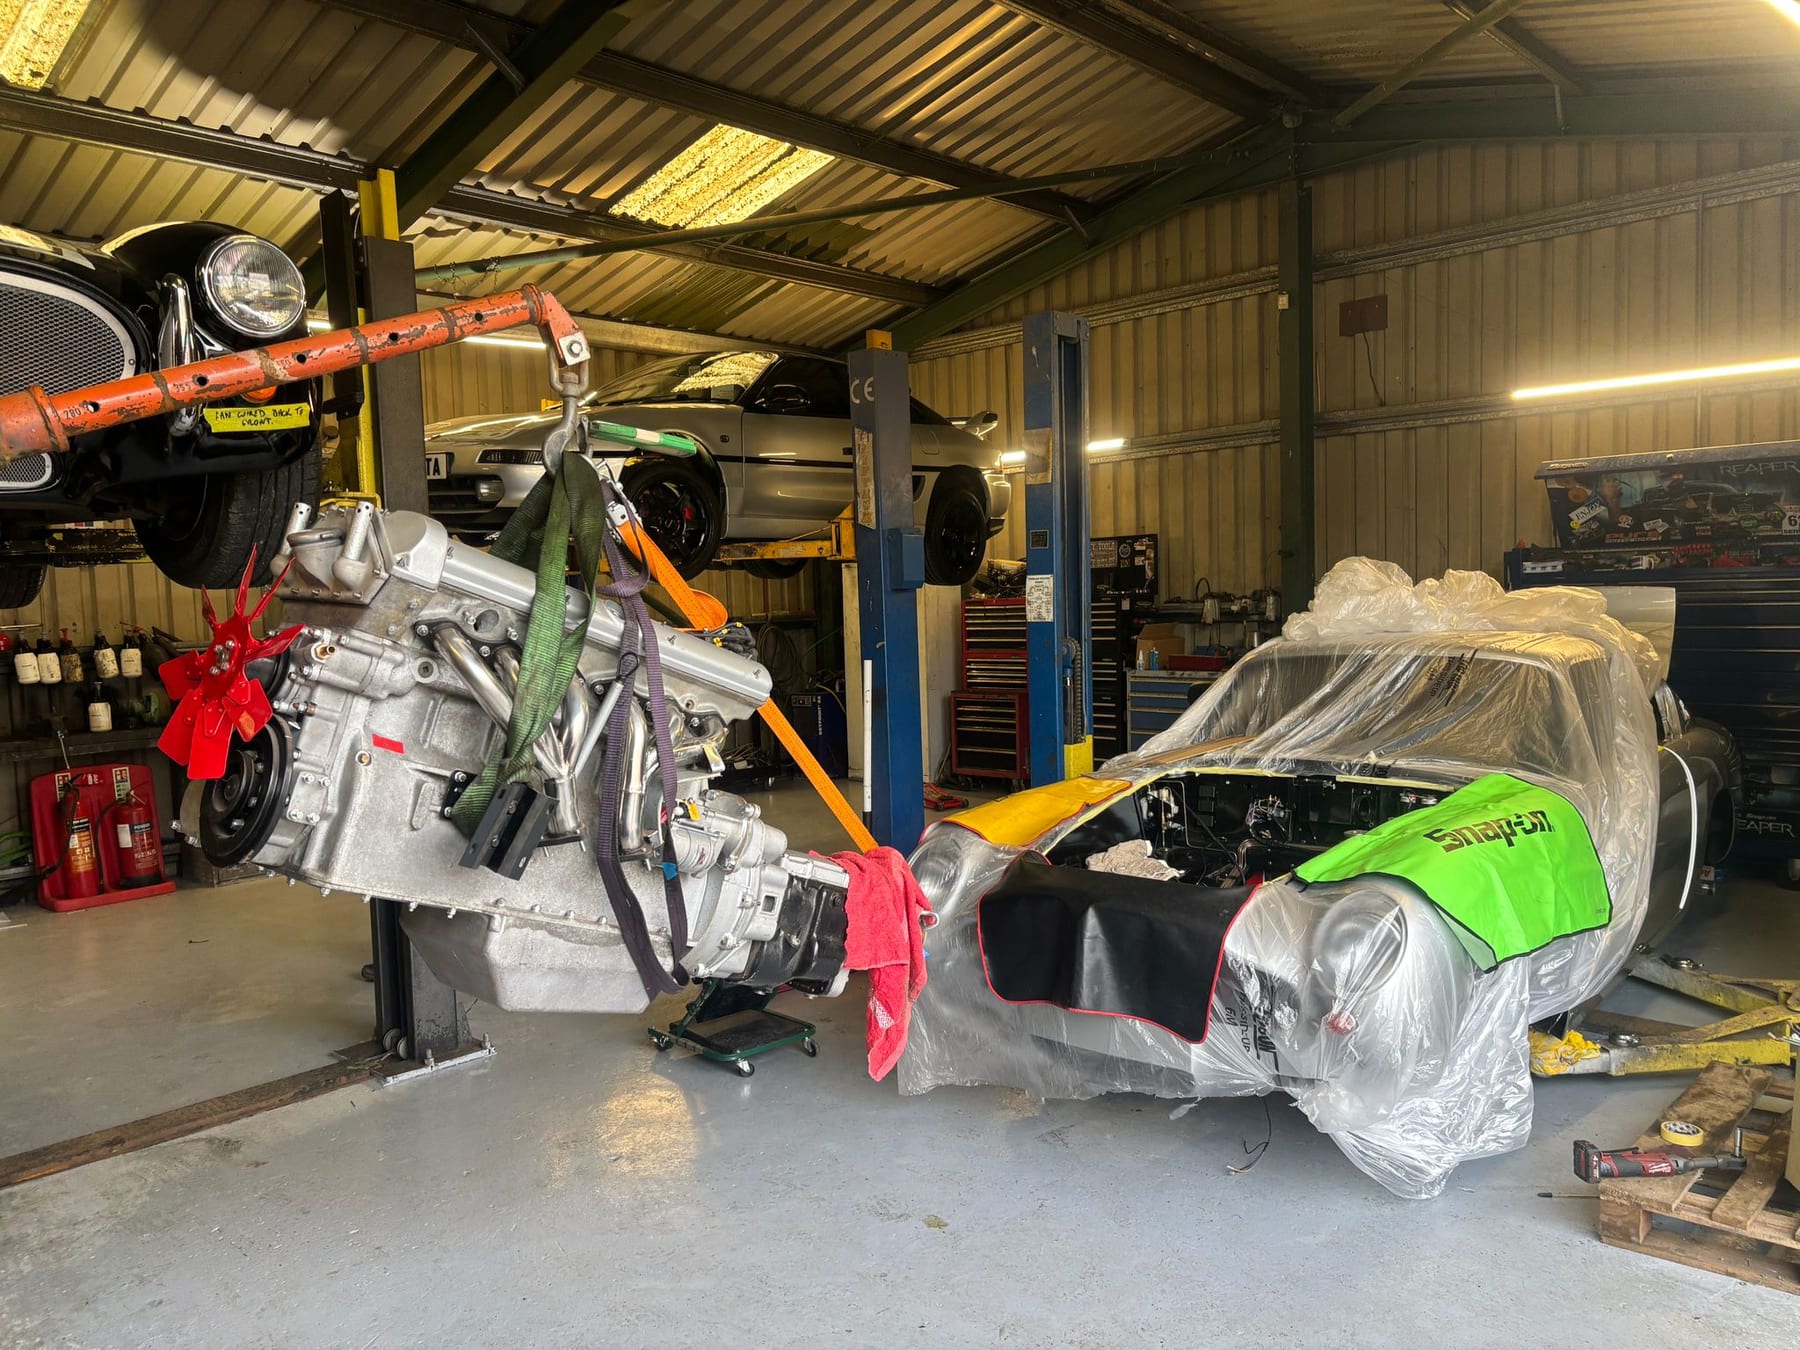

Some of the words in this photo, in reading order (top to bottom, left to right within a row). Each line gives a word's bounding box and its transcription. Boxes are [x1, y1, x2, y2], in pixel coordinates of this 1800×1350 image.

[851, 376, 875, 404] CE
[63, 407, 82, 420] 280
[1720, 461, 1800, 477] REAPER
[1575, 501, 1601, 521] ENJOY
[1423, 809, 1554, 853] Snap-on
[1735, 819, 1796, 838] EAPER
